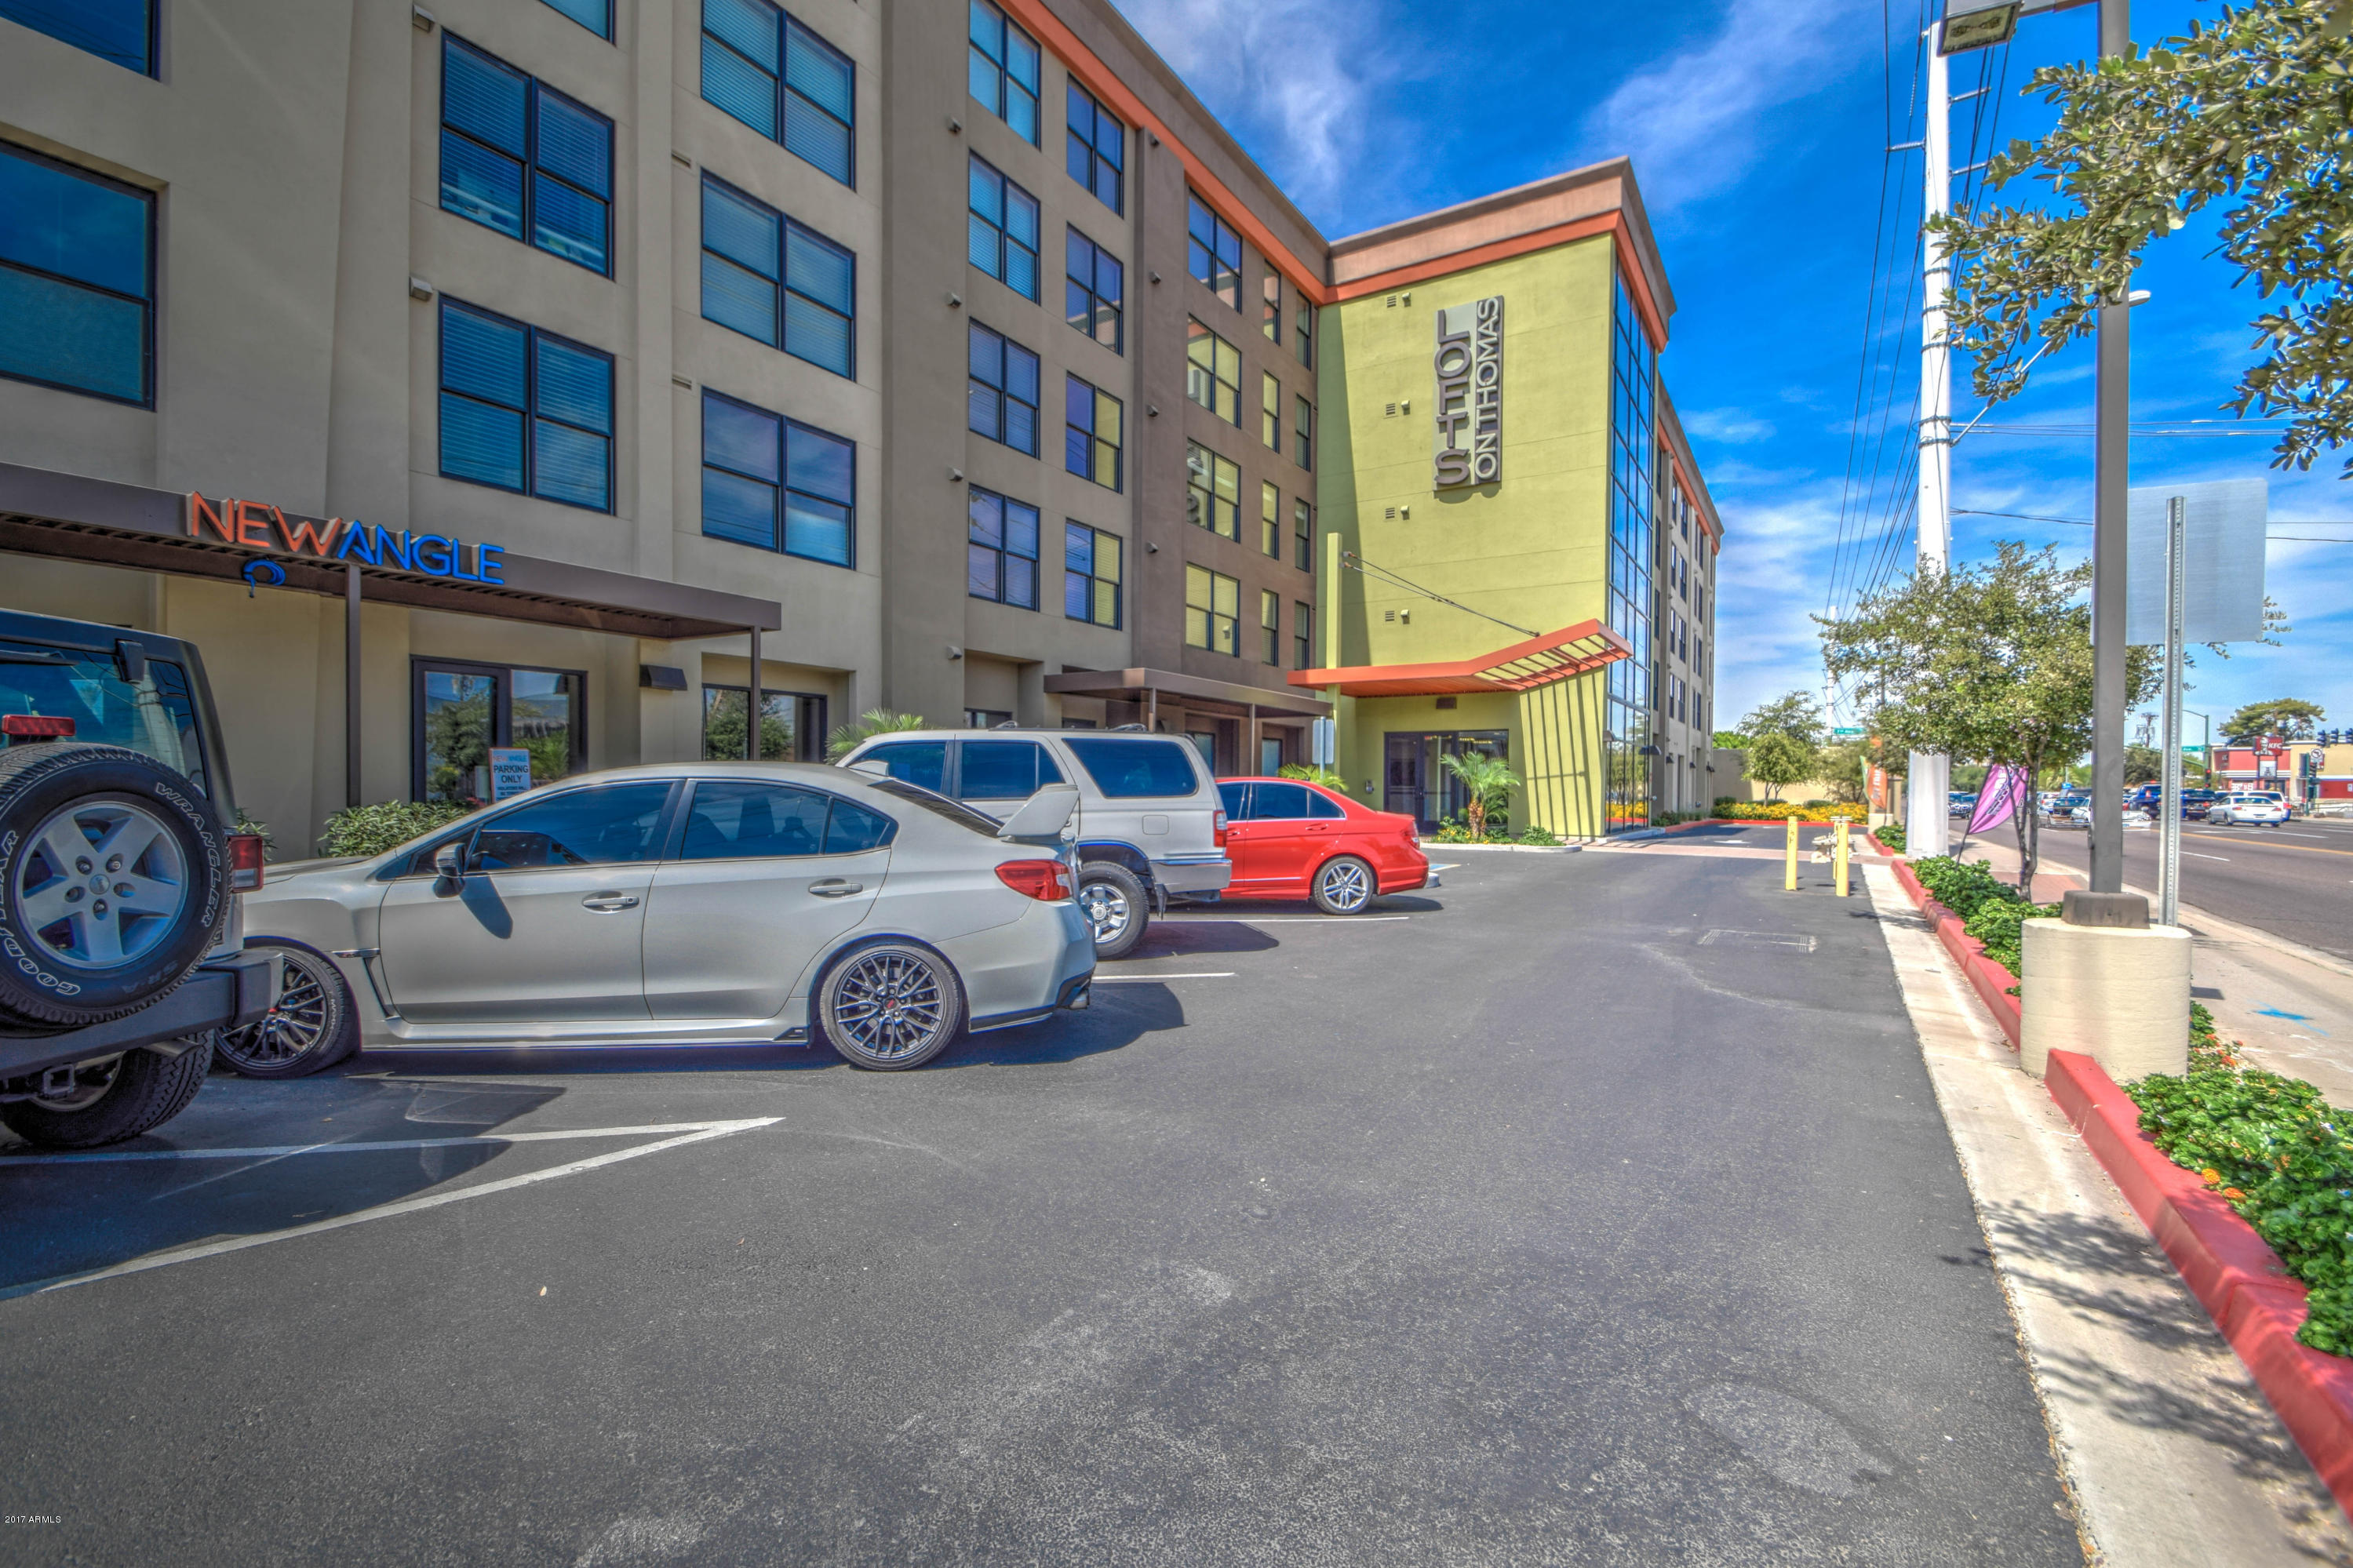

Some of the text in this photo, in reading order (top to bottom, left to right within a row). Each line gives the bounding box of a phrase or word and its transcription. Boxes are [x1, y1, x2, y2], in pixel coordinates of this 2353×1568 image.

[1434, 309, 1472, 485] LOFTS
[1475, 297, 1499, 480] ON THOMAS
[494, 765, 529, 773] PARKING
[501, 775, 523, 784] ONLY
[155, 780, 222, 928] WRANGLER
